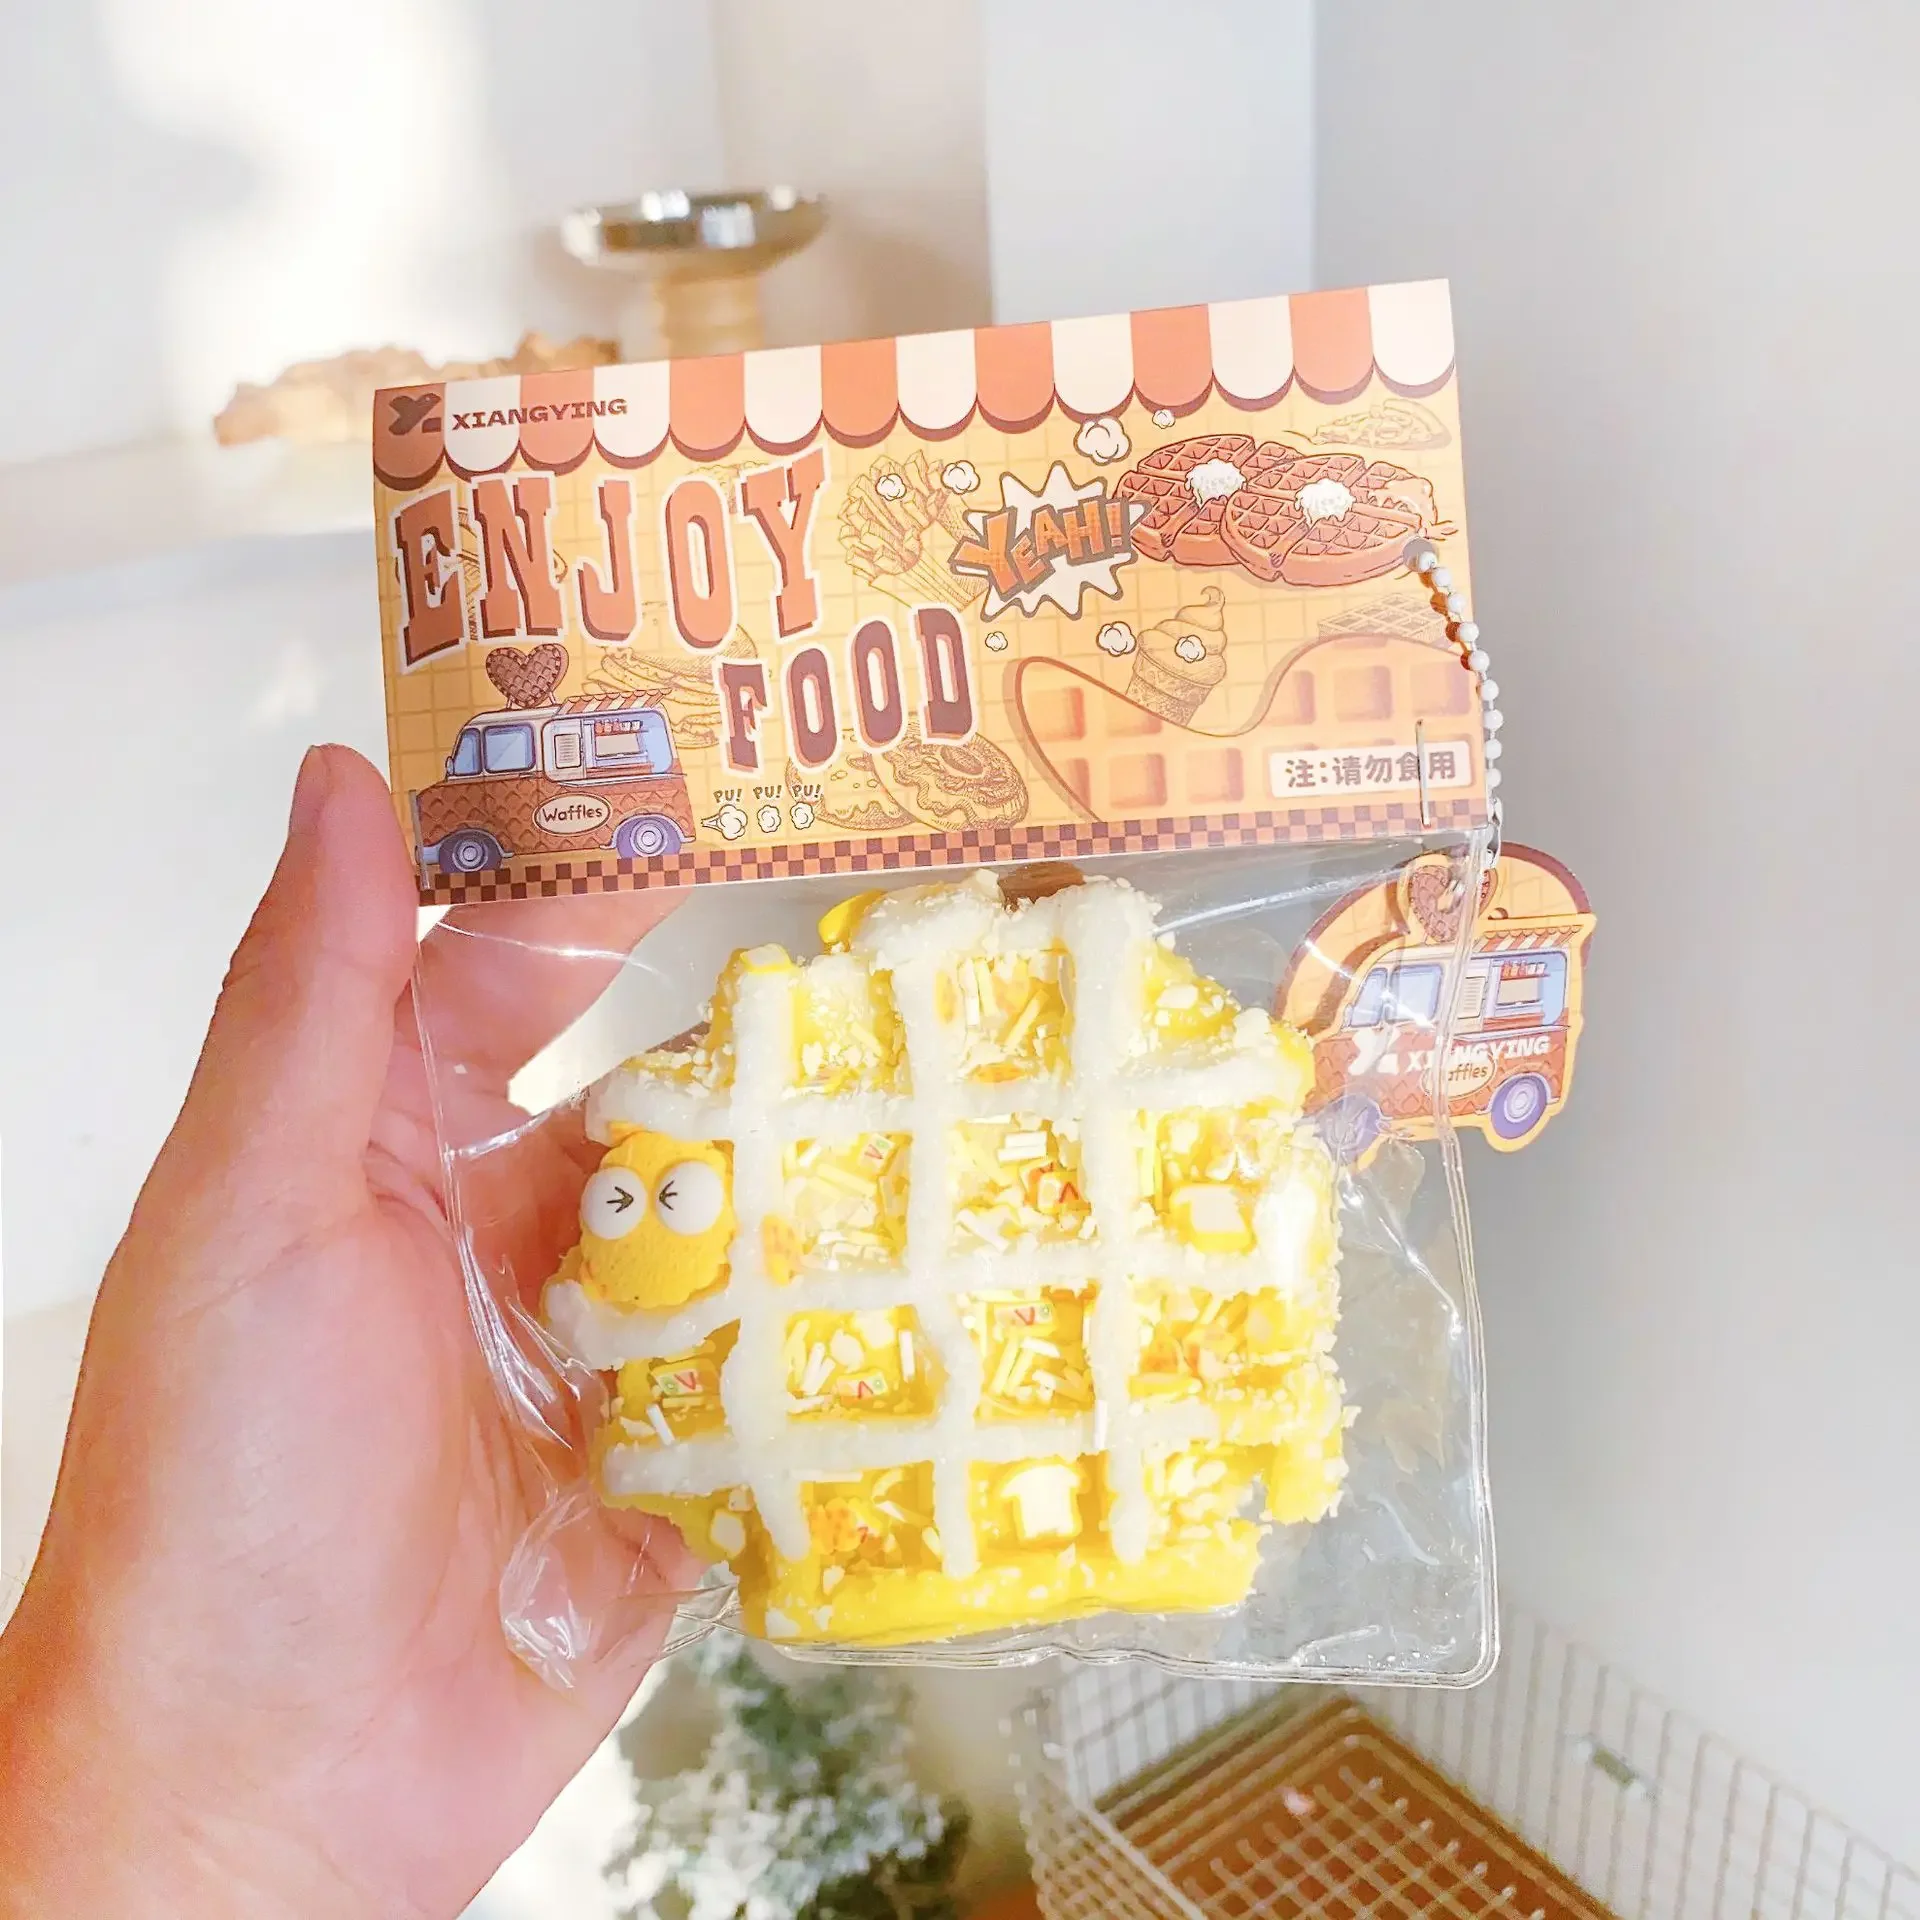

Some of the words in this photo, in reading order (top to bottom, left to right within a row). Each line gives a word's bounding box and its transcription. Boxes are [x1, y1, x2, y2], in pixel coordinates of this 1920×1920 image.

[452, 397, 628, 432] XIANGYING
[392, 445, 829, 664] ENJOY
[950, 498, 1128, 599] YEAH!
[718, 607, 974, 771] FOOD
[542, 804, 603, 823] Waffles
[712, 788, 743, 803] PU!
[752, 784, 783, 800] PU!
[791, 783, 822, 799] PU!
